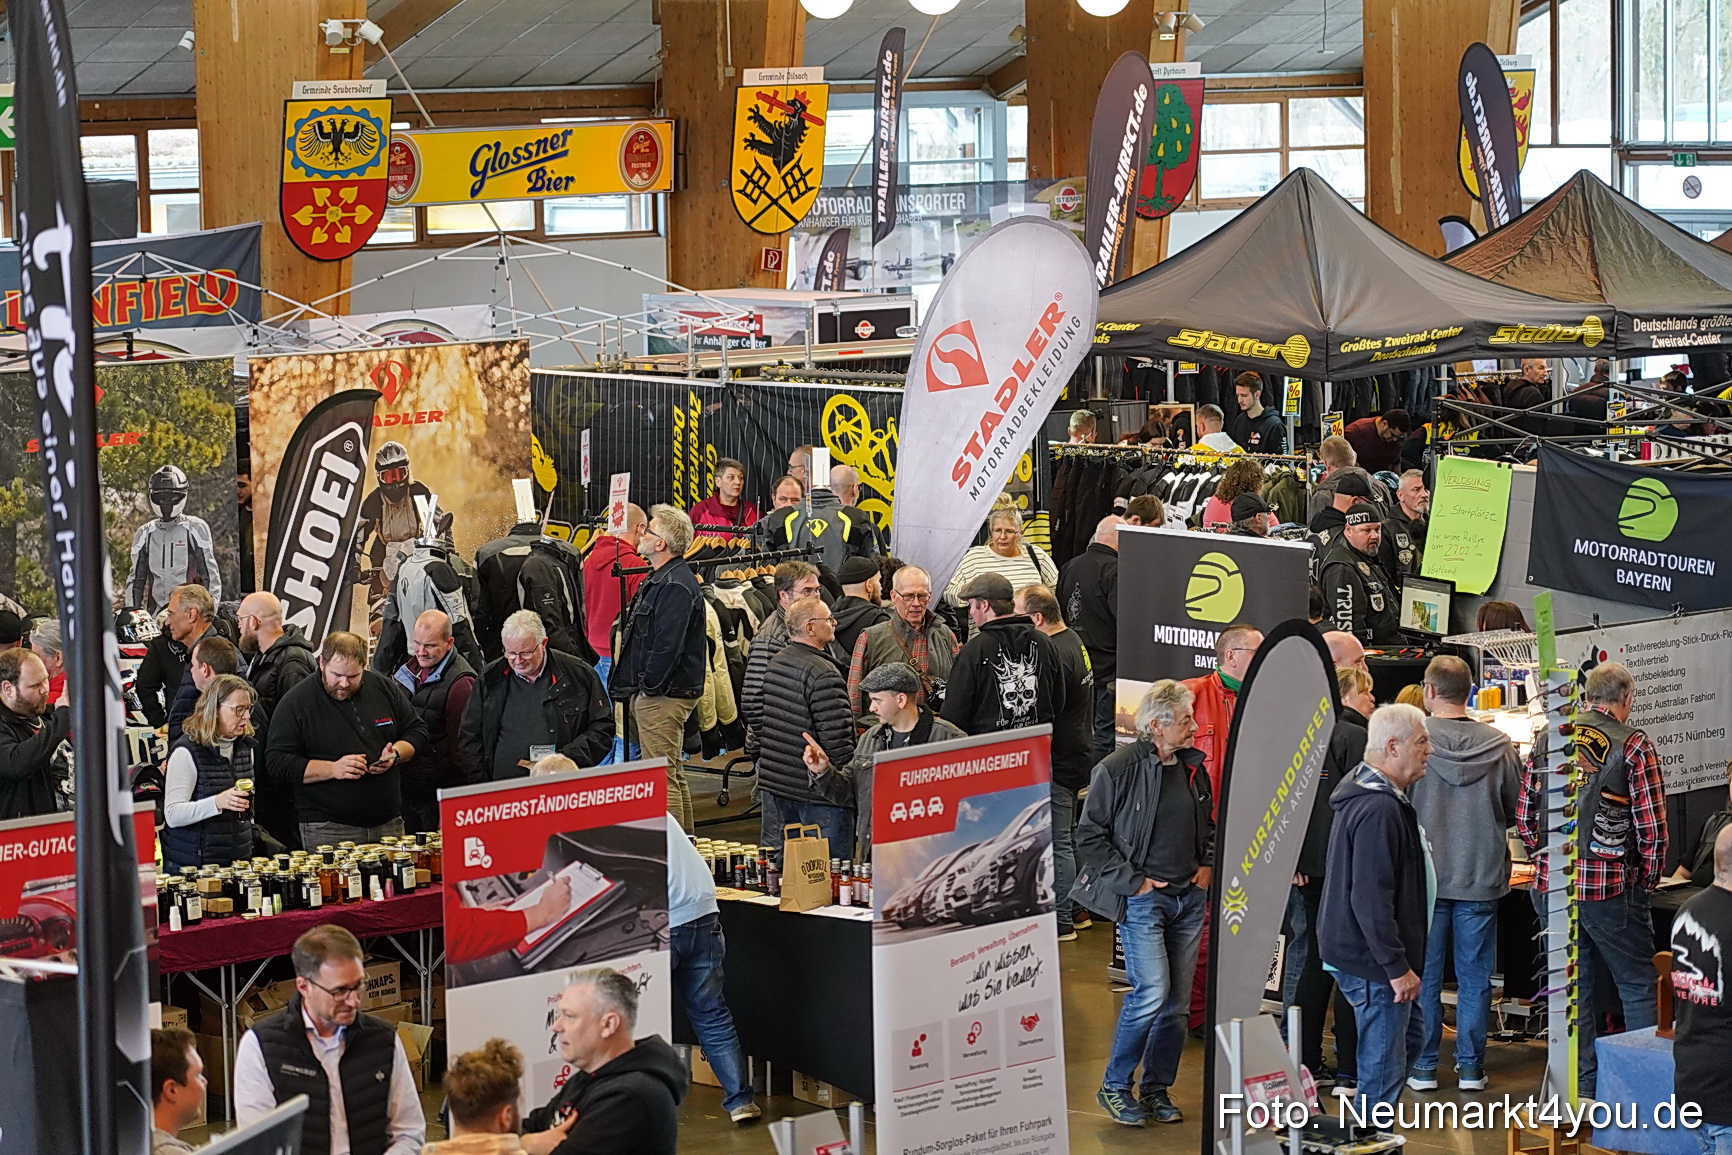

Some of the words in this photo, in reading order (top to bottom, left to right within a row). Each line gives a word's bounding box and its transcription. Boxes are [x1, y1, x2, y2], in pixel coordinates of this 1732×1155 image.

[759, 72, 785, 81] Gemeinde
[302, 84, 331, 95] Gemeinde
[333, 83, 374, 95] Seubersdorf
[877, 48, 893, 224] TRAILER-DIRECT.de
[469, 128, 574, 199] Glossner
[526, 166, 576, 194] Bier
[1095, 82, 1148, 291] RAILER-DIRECT.de
[799, 215, 844, 229] ANHÄNGER
[842, 213, 856, 227] FÜR
[857, 214, 873, 227] KUR
[93, 268, 240, 328] NFIELD
[1096, 322, 1142, 332] -Center
[1633, 317, 1698, 333] Deutschlands
[703, 335, 740, 349] Anhäger
[740, 338, 768, 349] Ceter
[1340, 336, 1383, 354] Größtes
[1384, 325, 1464, 348] Zweirad-Center
[1650, 331, 1722, 350] Zweirad-Center
[1369, 341, 1438, 363] Deutschlands
[950, 301, 1067, 491] STADLER
[968, 315, 1082, 502] MOTORRADBEKLEIDUNG
[25, 431, 142, 454] SLER
[673, 404, 687, 511] Deutsch
[1443, 468, 1492, 490] VERLOSUNG
[1436, 504, 1446, 518] 2
[1450, 504, 1498, 522] Startplätze
[281, 450, 361, 643] SHOEI
[1432, 529, 1442, 541] für
[1463, 530, 1485, 548] Rallye
[1573, 538, 1716, 577] MOTORRADTOUREN
[1426, 564, 1458, 576] Vogtland
[1616, 568, 1672, 593] BAYERN
[1336, 584, 1353, 634] TRUS
[1625, 629, 1732, 654] Textilveredelung-Stick-Druck-Flo
[1194, 654, 1218, 670] BAYE
[1625, 653, 1669, 668] Textilvertrieb
[1647, 682, 1683, 696] Collection
[1654, 696, 1689, 710] Australian
[1690, 691, 1716, 704] Fashion
[1627, 710, 1694, 728] Outdoorbekleidung
[1584, 729, 1608, 748] CHAPTER
[1656, 732, 1684, 747] 90475
[1685, 727, 1726, 742] Nürnberg
[899, 750, 1031, 788] FUHRPARKMANAGEMENT
[1690, 763, 1704, 773] nach
[1240, 696, 1331, 876] KURZENDORFER
[454, 780, 655, 828] SACHVERSTÄNDIGENBEREICH
[994, 943, 1035, 973] wissen
[365, 973, 396, 992] HNAPS.
[368, 990, 380, 999] KEIN
[958, 989, 981, 1013] was
[984, 978, 1003, 1001] Sie
[1018, 1037, 1044, 1048] Übernahme
[962, 1048, 988, 1059] Verwaltung
[909, 1061, 930, 1072] Beratung
[987, 1128, 999, 1139] für
[1000, 1124, 1019, 1137] Ihren
[1019, 1116, 1053, 1133] Fuhrpark
